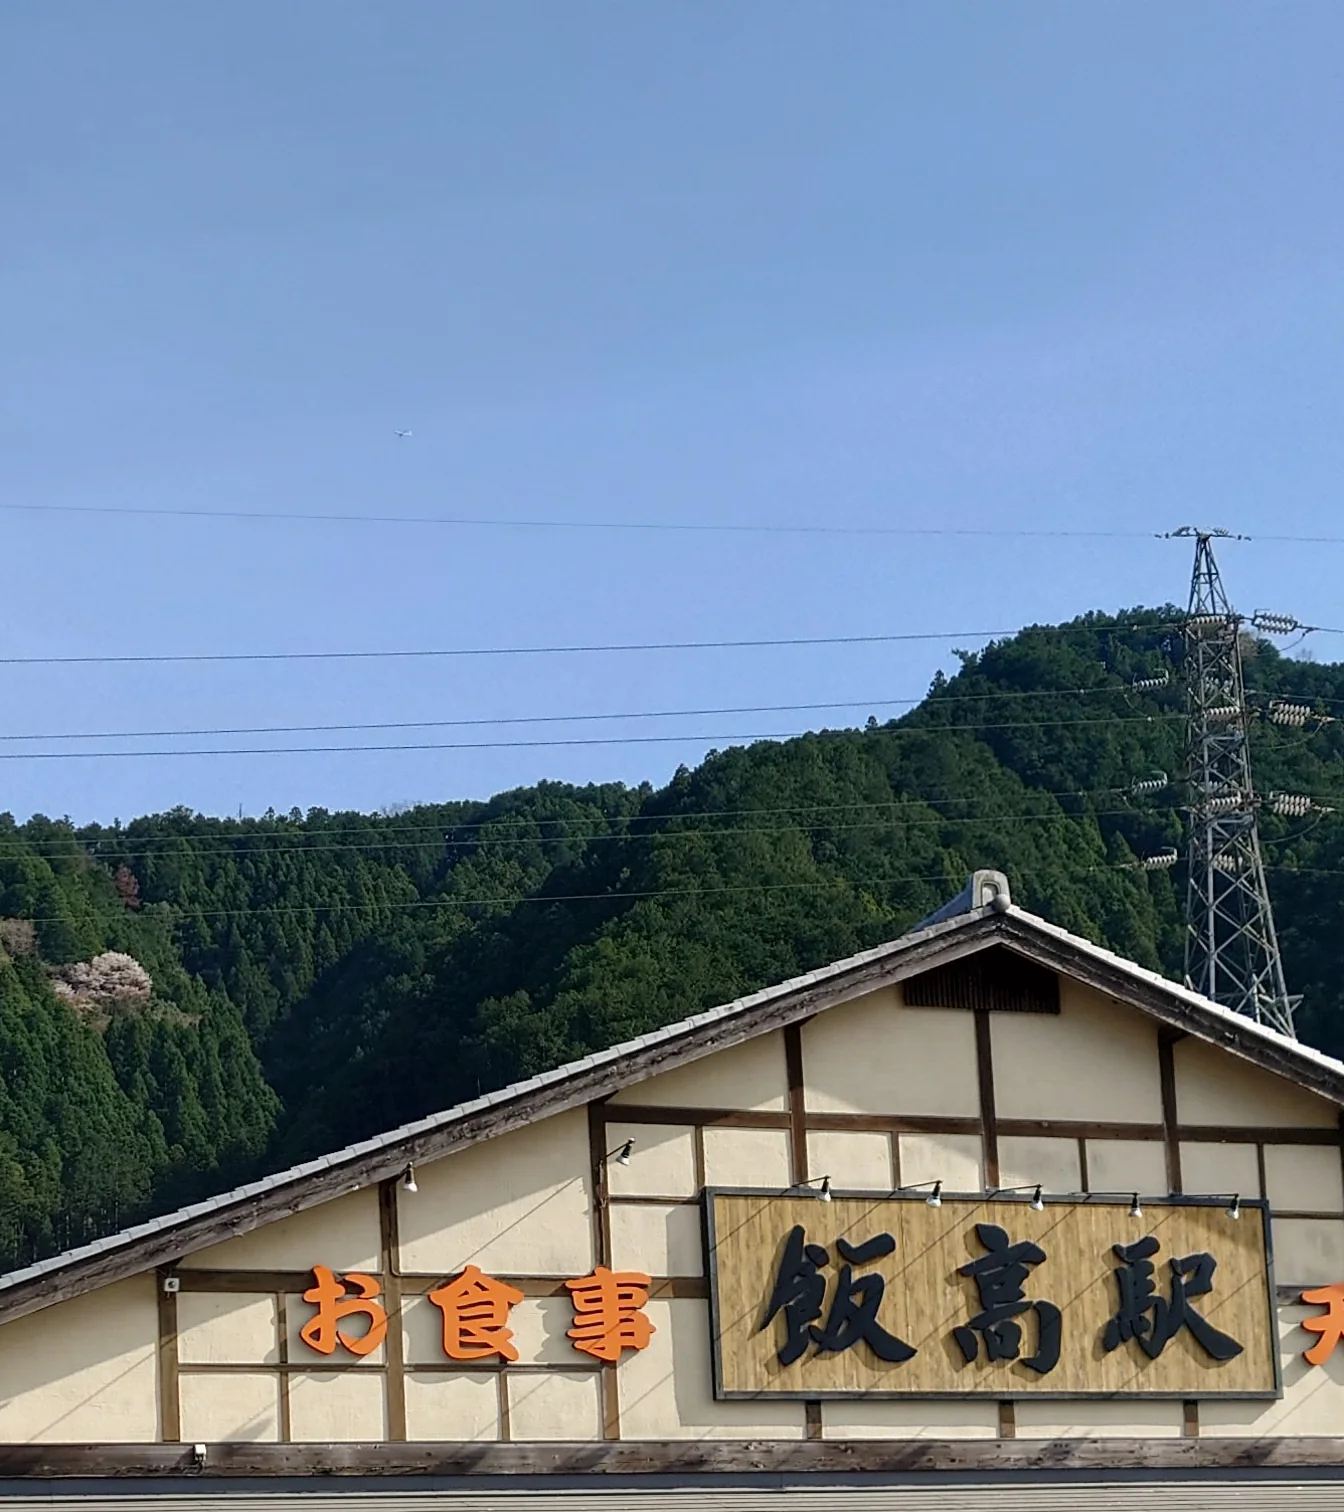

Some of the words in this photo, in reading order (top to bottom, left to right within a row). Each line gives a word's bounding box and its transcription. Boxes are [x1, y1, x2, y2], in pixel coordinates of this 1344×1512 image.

[301, 1264, 656, 1361] お食事
[759, 1223, 1244, 1374] 飯高駅
